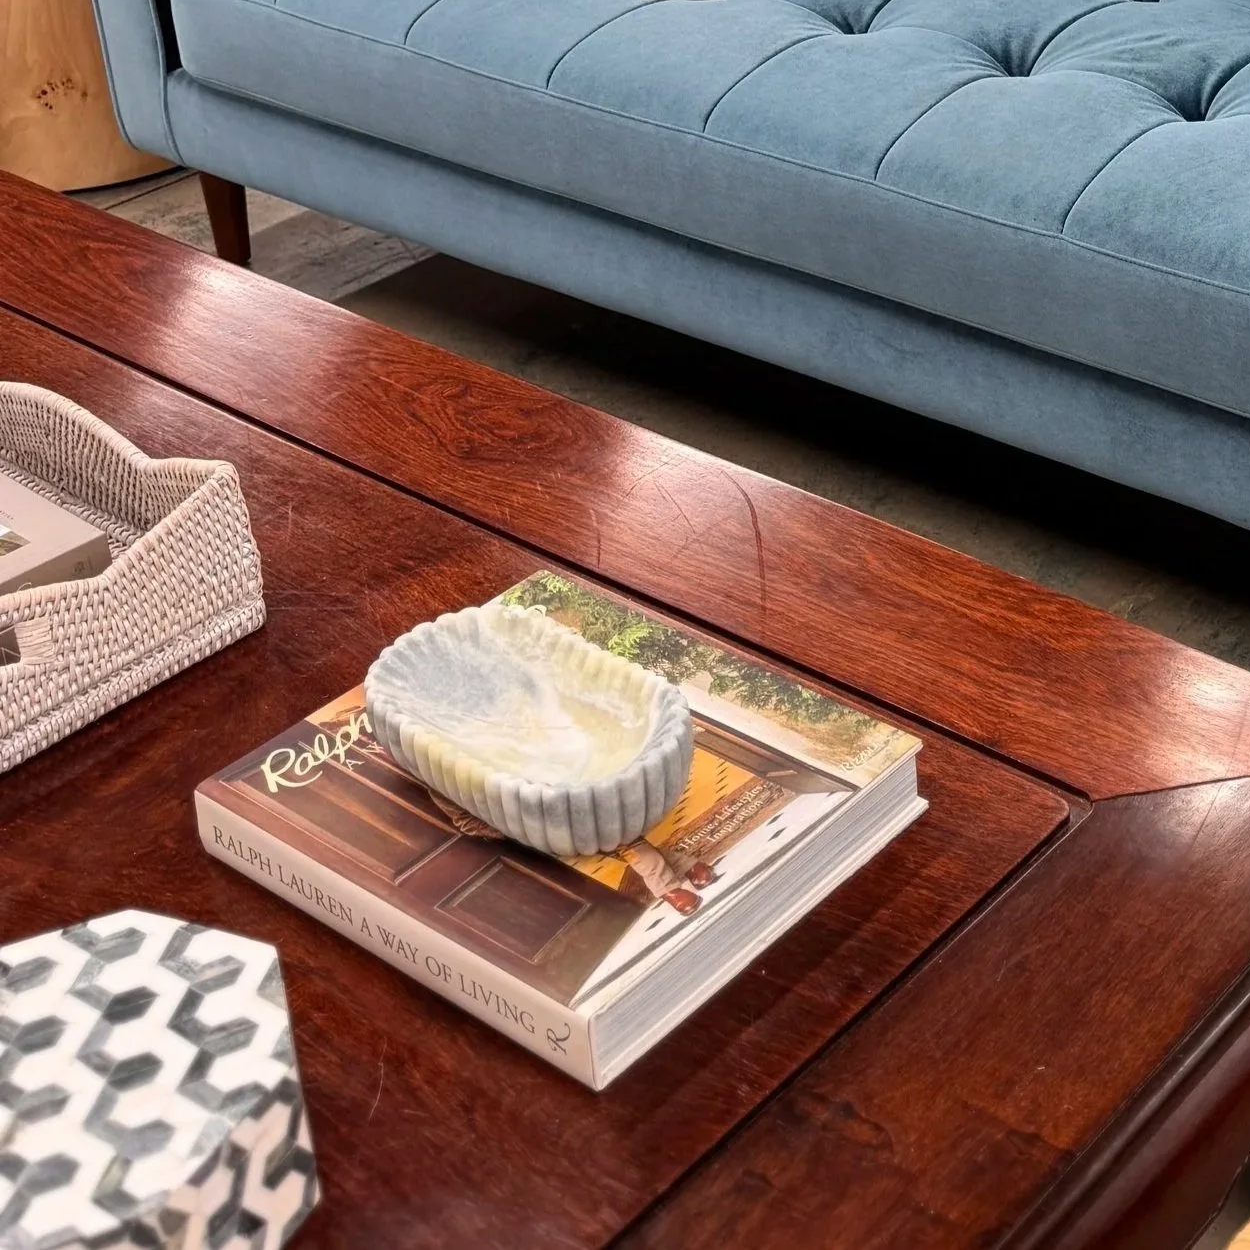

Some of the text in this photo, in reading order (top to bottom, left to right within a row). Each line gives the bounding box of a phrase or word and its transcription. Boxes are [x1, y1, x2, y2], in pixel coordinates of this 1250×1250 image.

[260, 712, 373, 793] Ralph
[213, 825, 274, 877] RALPH
[278, 864, 353, 926] LAUREN
[360, 917, 374, 939] A
[376, 925, 419, 965] WAY
[425, 955, 452, 983] OF
[458, 972, 535, 1035] LIVING
